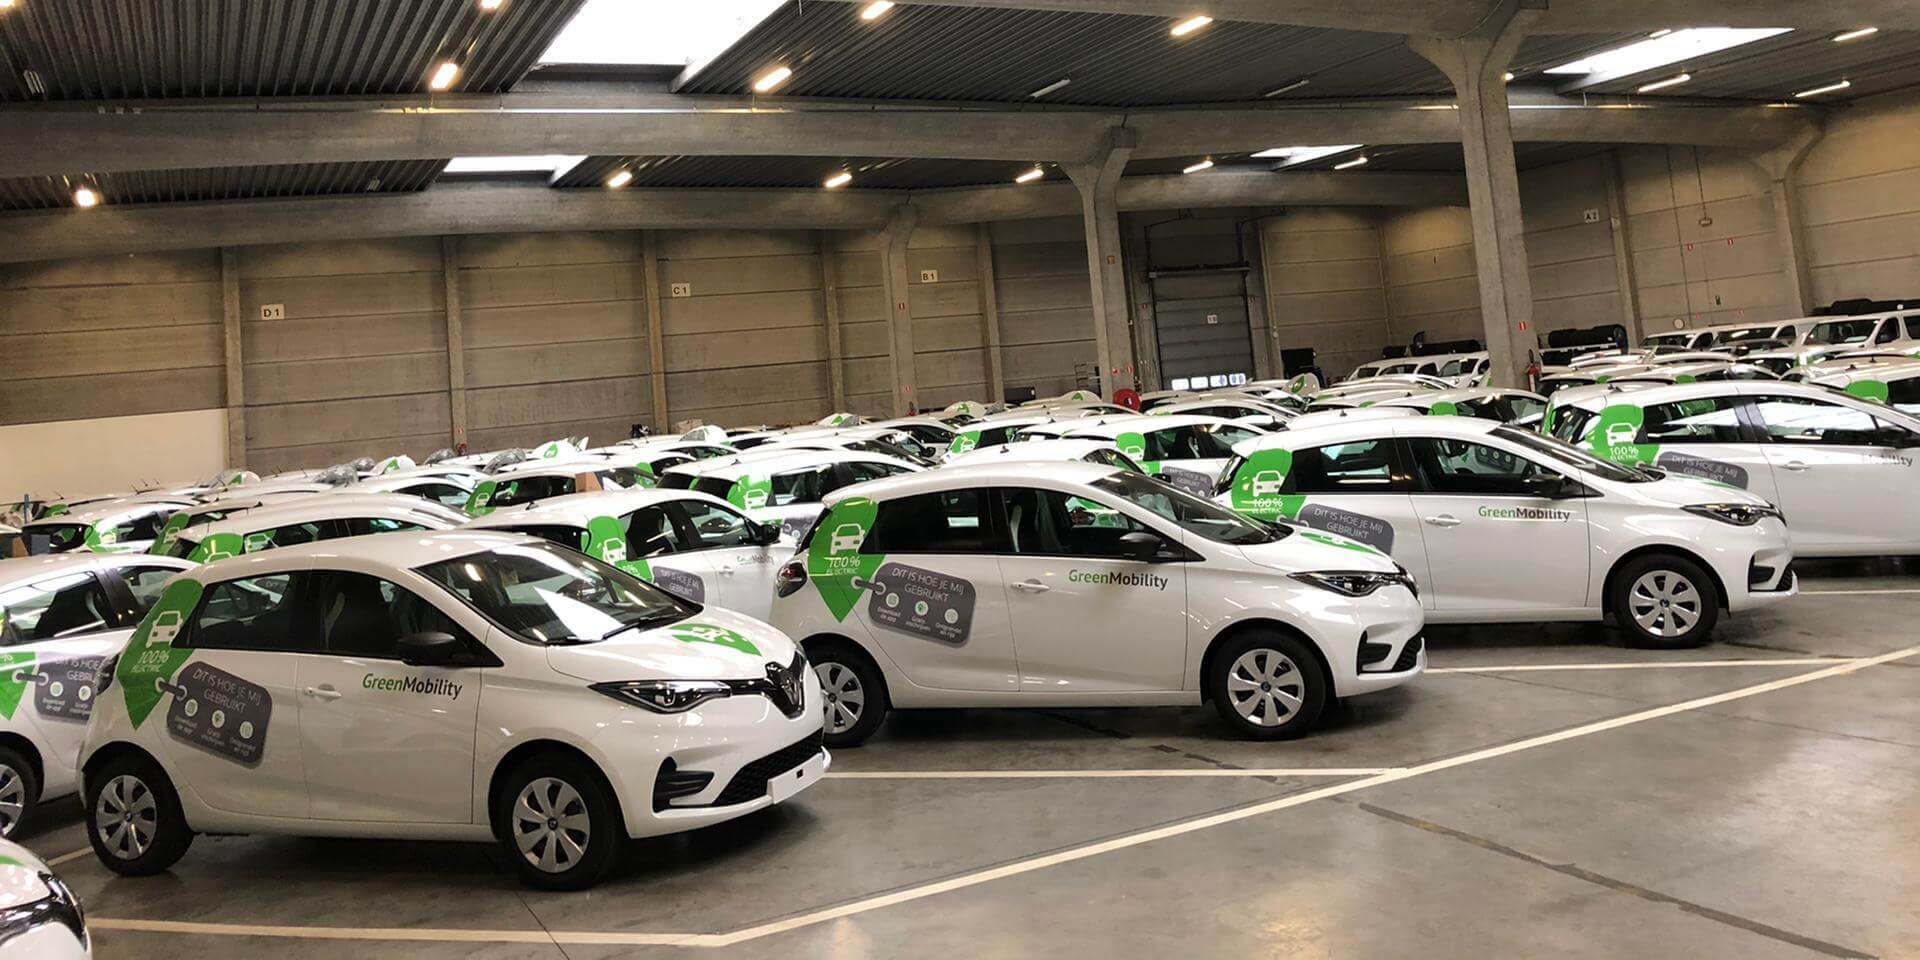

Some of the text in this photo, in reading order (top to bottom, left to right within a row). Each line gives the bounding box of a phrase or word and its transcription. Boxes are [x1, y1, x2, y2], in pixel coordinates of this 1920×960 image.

[923, 273, 929, 281] B
[673, 286, 680, 295] C
[263, 309, 272, 318] D
[1610, 446, 1639, 456] 100%
[1254, 498, 1283, 508] 100%
[1314, 508, 1384, 534] DIT IS HOE JE MIJ
[1478, 505, 1571, 523] GreenMobility
[1326, 522, 1369, 539] GEBRUIKT
[829, 556, 861, 568] 100%
[891, 567, 965, 596] DIT IS HOE JE MIJ
[1068, 569, 1169, 591] GreenMobility
[904, 583, 950, 602] GEBRUIKT
[137, 650, 170, 664] 100%
[192, 668, 262, 706] DIT IS HOE JE MIJ
[362, 672, 463, 701] GreenMobility
[203, 688, 247, 713] GEBRUIKT
